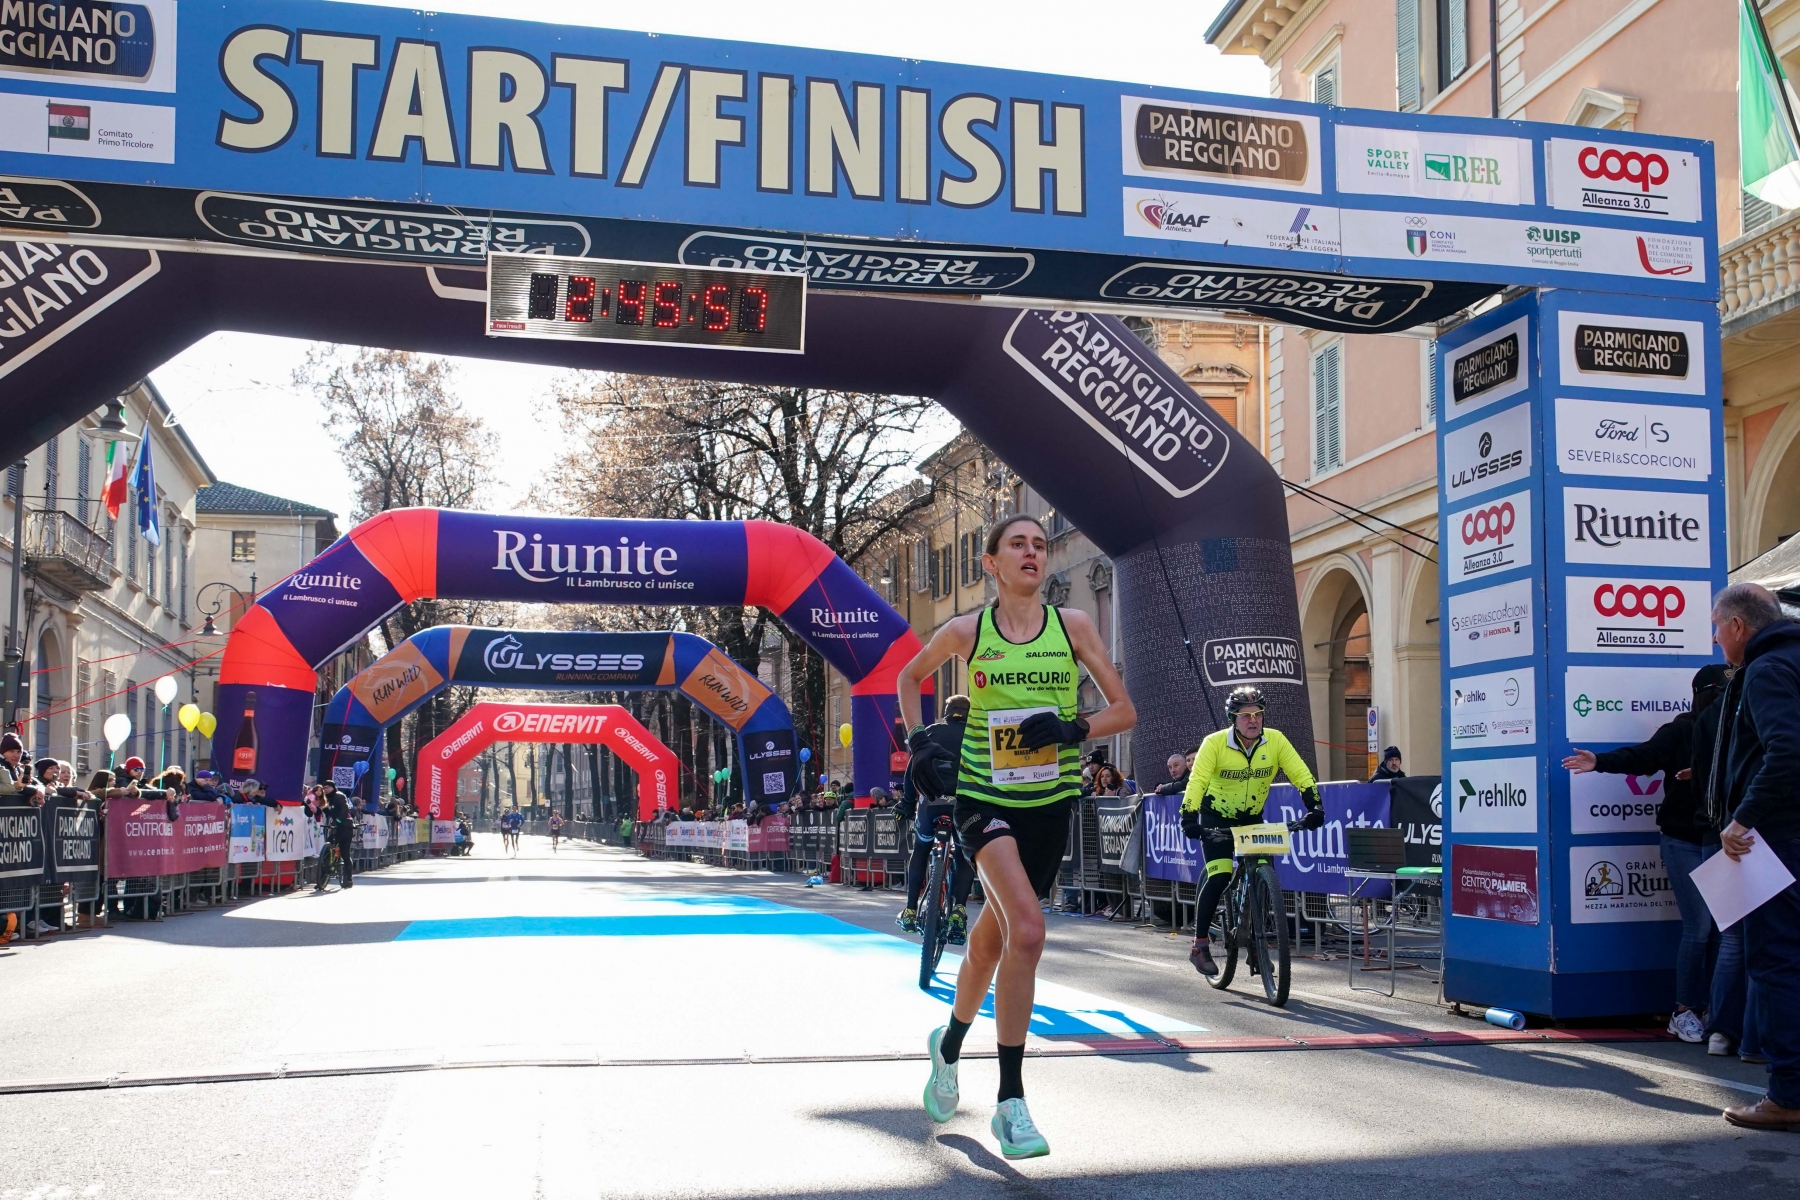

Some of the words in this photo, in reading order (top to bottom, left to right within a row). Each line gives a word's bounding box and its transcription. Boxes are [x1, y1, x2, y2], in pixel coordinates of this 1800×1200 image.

[0, 1, 136, 38] MIGIANO
[0, 29, 117, 65] GGIANO
[216, 24, 1086, 217] START/FINISH
[1150, 112, 1293, 148] PARMIGIANO
[98, 128, 133, 139] Comitato
[98, 138, 120, 147] Primo
[121, 139, 154, 149] Tricolore
[1164, 138, 1280, 171] REGGIANO
[1367, 149, 1408, 160] SPORT
[1367, 159, 1410, 170] VALLEY
[1578, 146, 1669, 192] coop
[1582, 192, 1630, 208] Alleanza
[1633, 198, 1650, 210] 3.0
[265, 207, 525, 243] REGGIANO
[1164, 225, 1192, 233] Athletics
[1166, 212, 1211, 228] IAAF
[1266, 234, 1310, 245] FEDERAZINE
[1312, 238, 1341, 247] ITALIANA
[1430, 230, 1456, 240] CONI
[1543, 228, 1581, 244] UISP
[1648, 237, 1692, 247] FONDAZIONE
[744, 245, 979, 275] REGGIANO
[1527, 246, 1582, 259] sportpertutti
[1660, 251, 1684, 259] COMUNE
[1167, 273, 1381, 301] REGGIANO
[566, 275, 767, 330] 2:45:57
[1126, 285, 1386, 320] PARMIGIANO
[1584, 330, 1680, 353] PARMIGIANO
[1458, 340, 1514, 379] PARMIGIANO
[1594, 349, 1671, 370] REGGIANO
[1050, 310, 1213, 450] PARMIGIANO
[1463, 361, 1507, 393] REGGIANO
[1042, 336, 1181, 461] REGGIANO
[1595, 419, 1639, 442] Ford
[1568, 449, 1696, 468] SEVERI&SCORCIONI
[1452, 450, 1523, 489] ULYSSES
[1462, 501, 1515, 546] coop
[1574, 504, 1699, 547] Riunite
[492, 530, 678, 582] Riunite
[1463, 557, 1491, 572] Alleanza
[1492, 552, 1503, 564] 3.0
[288, 571, 361, 590] Riunite
[566, 577, 575, 587] Il
[578, 577, 642, 589] Lambrusco
[645, 578, 655, 589] ci
[658, 579, 695, 590] unisce
[289, 594, 326, 604] Lambrusco
[335, 599, 358, 607] unisce
[1594, 584, 1685, 626] coop
[810, 607, 879, 627] Riunite
[1461, 603, 1528, 628] SEVERI&SCORCIONI
[818, 631, 851, 639] Lambrusco
[859, 631, 879, 639] unisce
[1489, 627, 1511, 636] HONDA
[1597, 632, 1645, 644] Alleanza
[1648, 633, 1666, 644] 3.0
[491, 652, 645, 671] ULYSSES
[1025, 651, 1068, 659] SALOMON
[1213, 642, 1297, 661] PARMIGIANO
[556, 673, 597, 681] RUNNING
[597, 673, 640, 681] COMPANY
[1226, 659, 1294, 676] REGGIANO
[698, 674, 726, 694] RUN
[990, 671, 1071, 686] MERCURIO
[372, 682, 396, 706] RUN
[1464, 690, 1486, 703] rehlko
[1596, 700, 1623, 712] BCC
[1631, 700, 1691, 712] EMILBAN
[523, 713, 608, 735] ENERVIT
[452, 721, 484, 752] ENERVIT
[324, 743, 370, 753] ULYSSES
[624, 735, 660, 762] ENERVIT
[749, 749, 791, 760] ULYSSES
[431, 764, 442, 805] ENERVIT
[1033, 770, 1055, 780] Riunite
[1478, 783, 1526, 807] rehlko
[1590, 803, 1660, 820] coopser
[0, 815, 38, 838] MIGIANO
[1397, 822, 1443, 846] ULYS
[1252, 834, 1284, 844] DONNA
[62, 839, 92, 860] REGGIANO
[1317, 862, 1322, 873] Il
[1323, 864, 1351, 875] Lambru
[1626, 862, 1656, 871] GRAN
[1627, 873, 1674, 897] Riun
